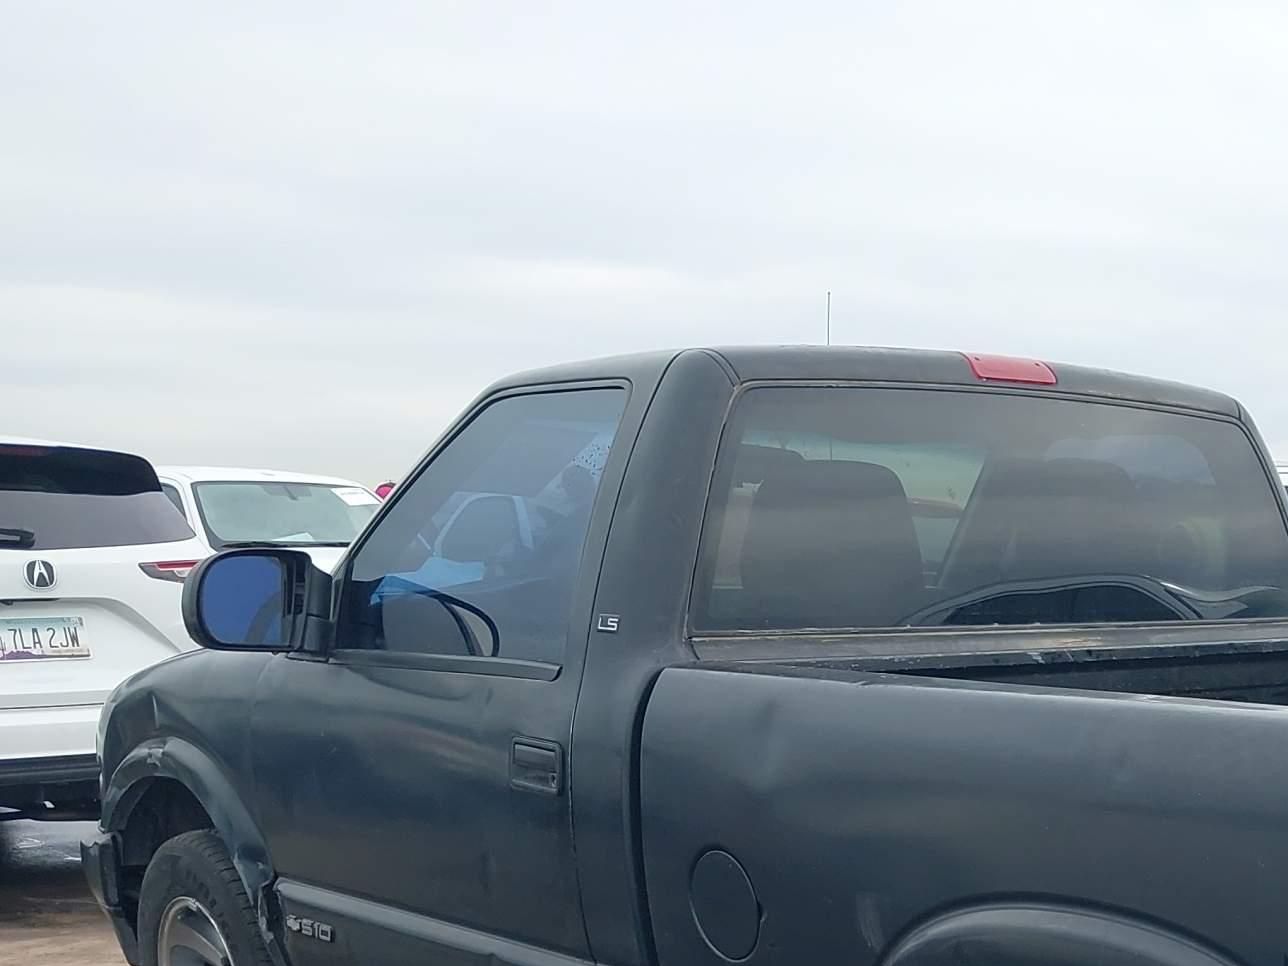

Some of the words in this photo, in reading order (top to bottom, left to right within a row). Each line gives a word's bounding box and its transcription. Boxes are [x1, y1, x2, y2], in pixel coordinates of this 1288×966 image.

[597, 616, 619, 631] LS
[46, 626, 80, 648] 2JW
[301, 918, 333, 942] S10
